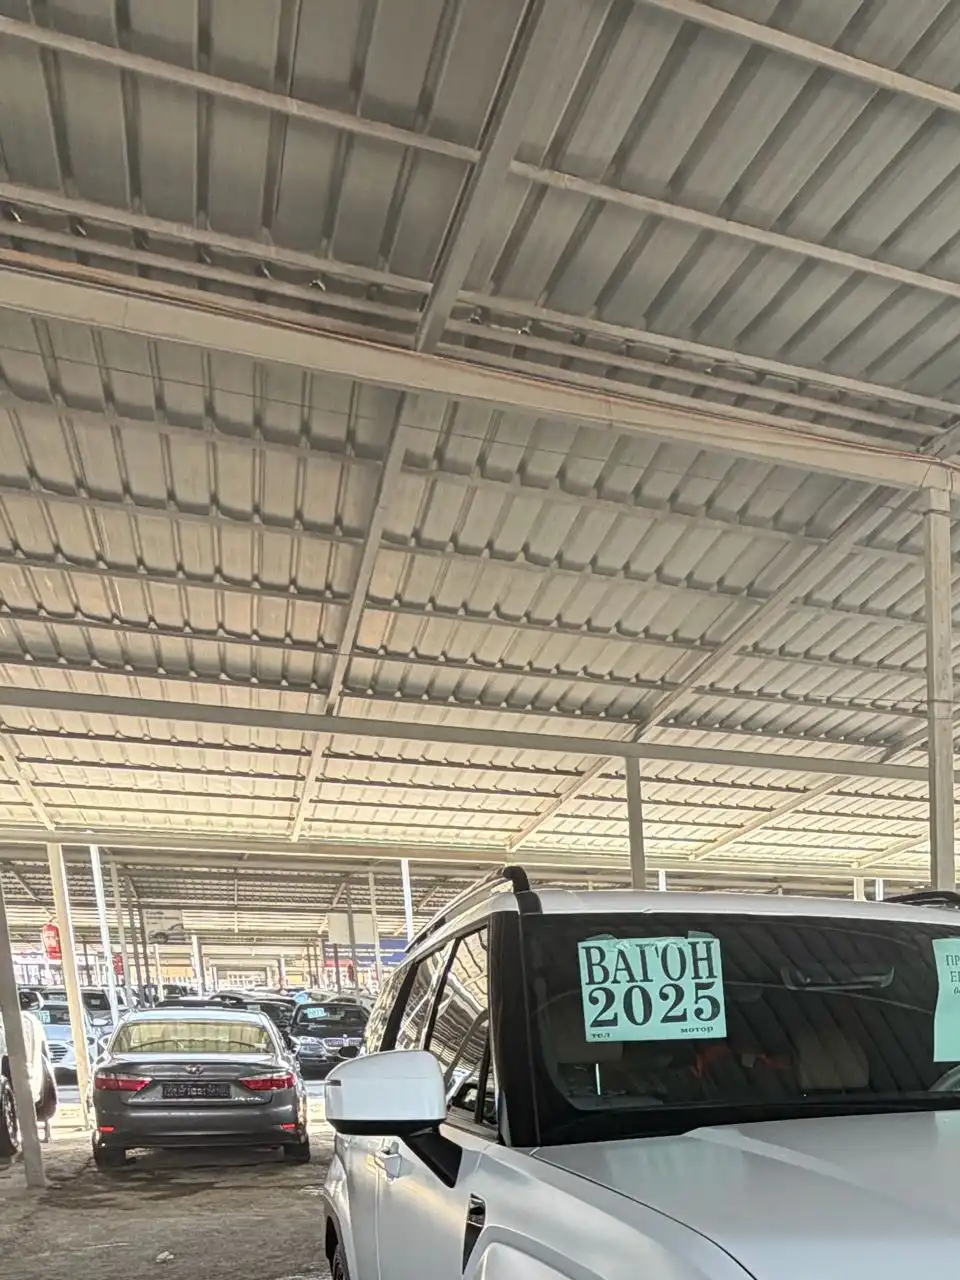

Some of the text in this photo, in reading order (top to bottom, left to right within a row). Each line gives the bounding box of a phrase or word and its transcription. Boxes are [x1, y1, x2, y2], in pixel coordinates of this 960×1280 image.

[581, 940, 718, 985] ВАГОН
[588, 981, 721, 1028] 2025
[680, 1026, 714, 1034] мотор
